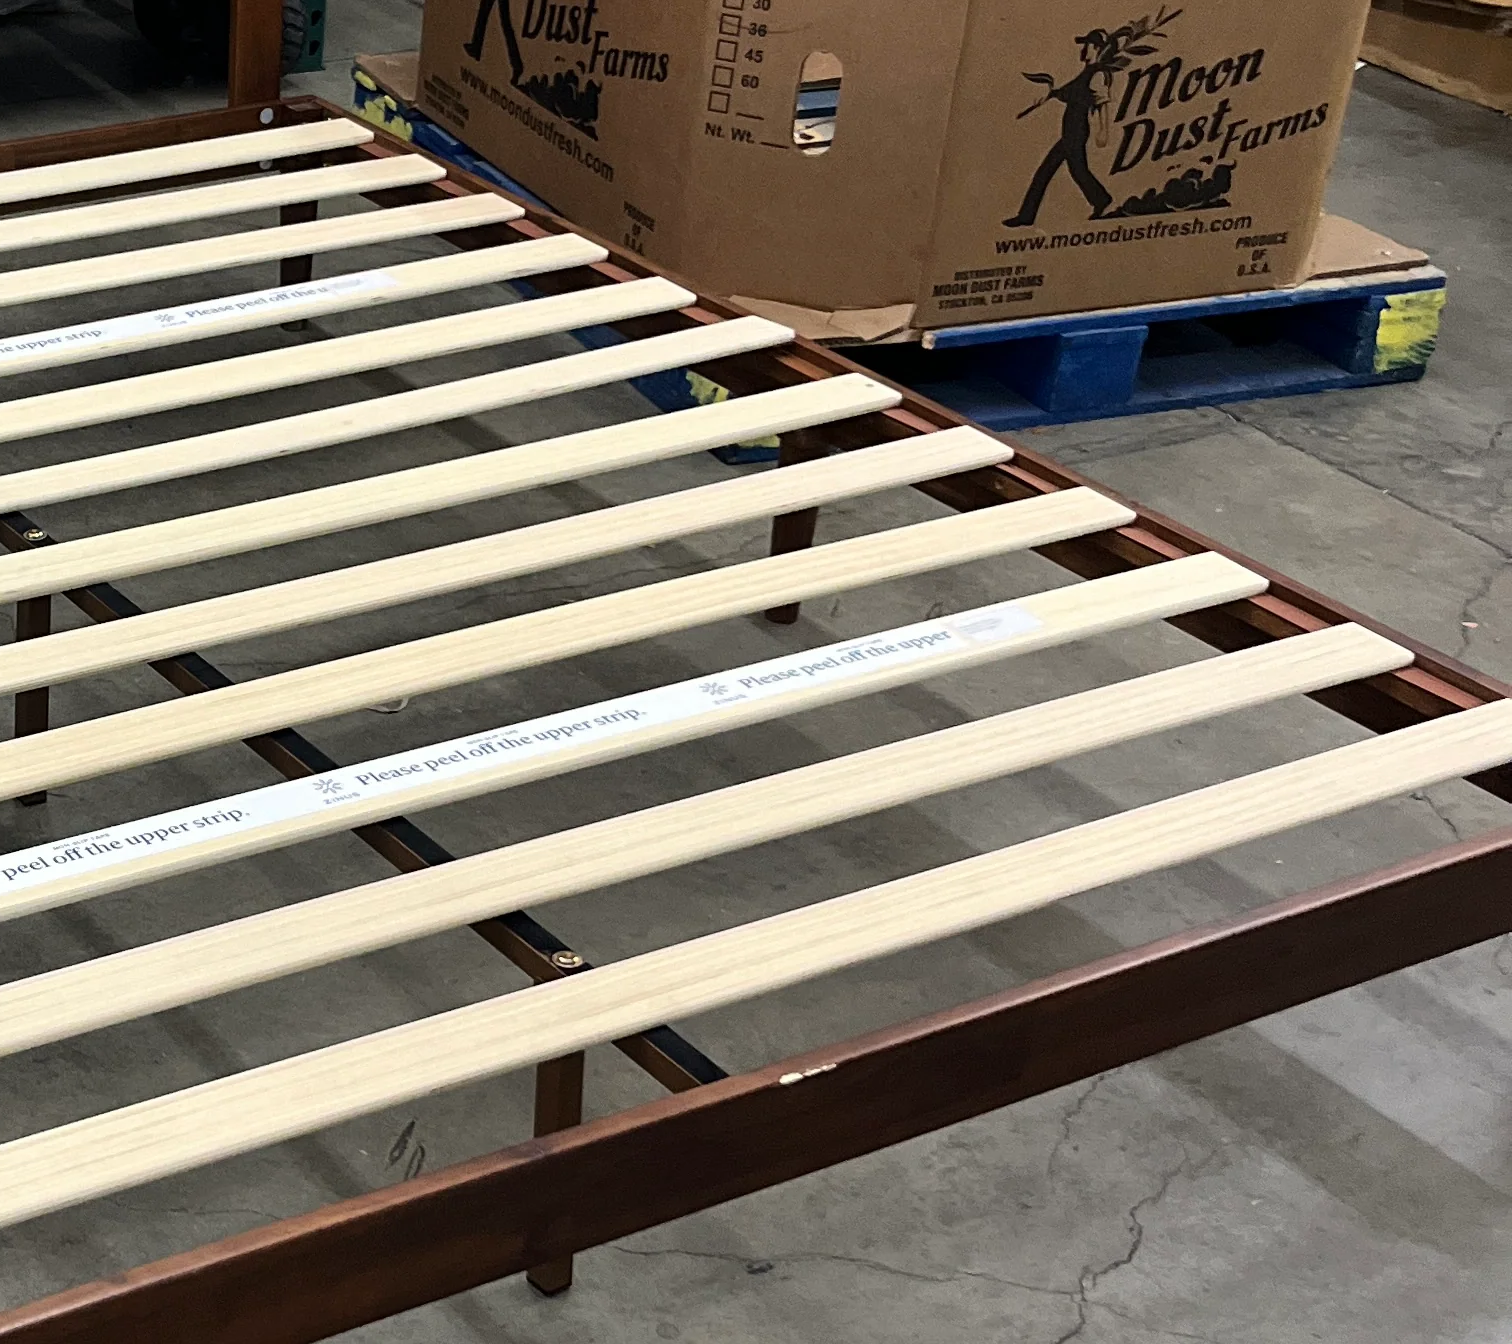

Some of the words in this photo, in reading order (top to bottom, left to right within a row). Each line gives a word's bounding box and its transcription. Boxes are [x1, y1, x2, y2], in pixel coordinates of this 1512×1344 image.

[744, 47, 764, 64] 45
[748, 21, 768, 38] 36
[589, 30, 670, 83] Farms
[741, 74, 759, 89] 60
[1112, 46, 1266, 124] Moon
[459, 65, 615, 183] www.moondustfresh.com
[1110, 98, 1232, 176] Dust
[1218, 102, 1330, 159] Farms
[994, 212, 1253, 254] www.moondustfresh.com
[932, 283, 968, 297] MOON
[970, 279, 1001, 293] DUST
[16, 335, 63, 353] upper
[738, 667, 801, 689] Please
[800, 657, 839, 676] peel
[838, 650, 865, 664] off
[865, 641, 898, 658] the
[898, 629, 952, 650] upper
[355, 761, 424, 787] Please
[424, 750, 469, 773] peel
[471, 742, 496, 759] off
[497, 734, 533, 752] the
[535, 719, 598, 742] upper
[596, 706, 648, 727] strip.
[1, 856, 50, 881] peel
[53, 845, 85, 865] off
[85, 837, 125, 857] the
[127, 822, 190, 847] upper
[192, 806, 251, 829] strip.
